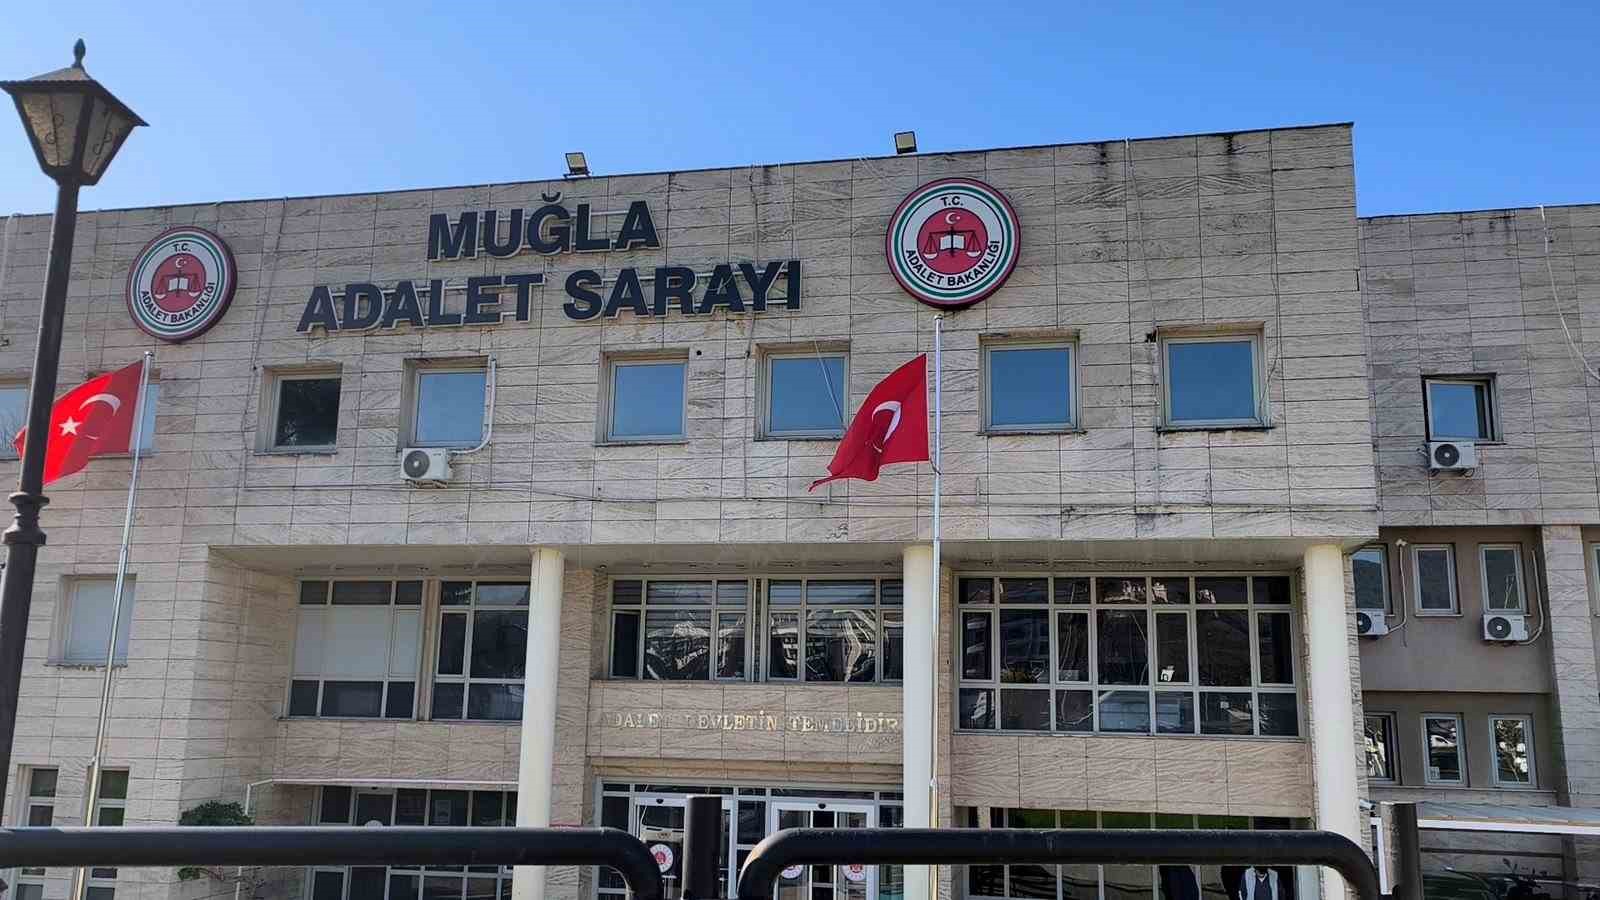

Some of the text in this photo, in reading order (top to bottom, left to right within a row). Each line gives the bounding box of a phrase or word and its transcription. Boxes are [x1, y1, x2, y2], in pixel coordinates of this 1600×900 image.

[939, 196, 964, 207] T.C.
[427, 191, 661, 260] MUĞLA
[173, 243, 191, 252] T.C.
[906, 249, 944, 285] ADALET
[141, 290, 169, 322] ADALET
[297, 260, 803, 333] ADALET SARAYI
